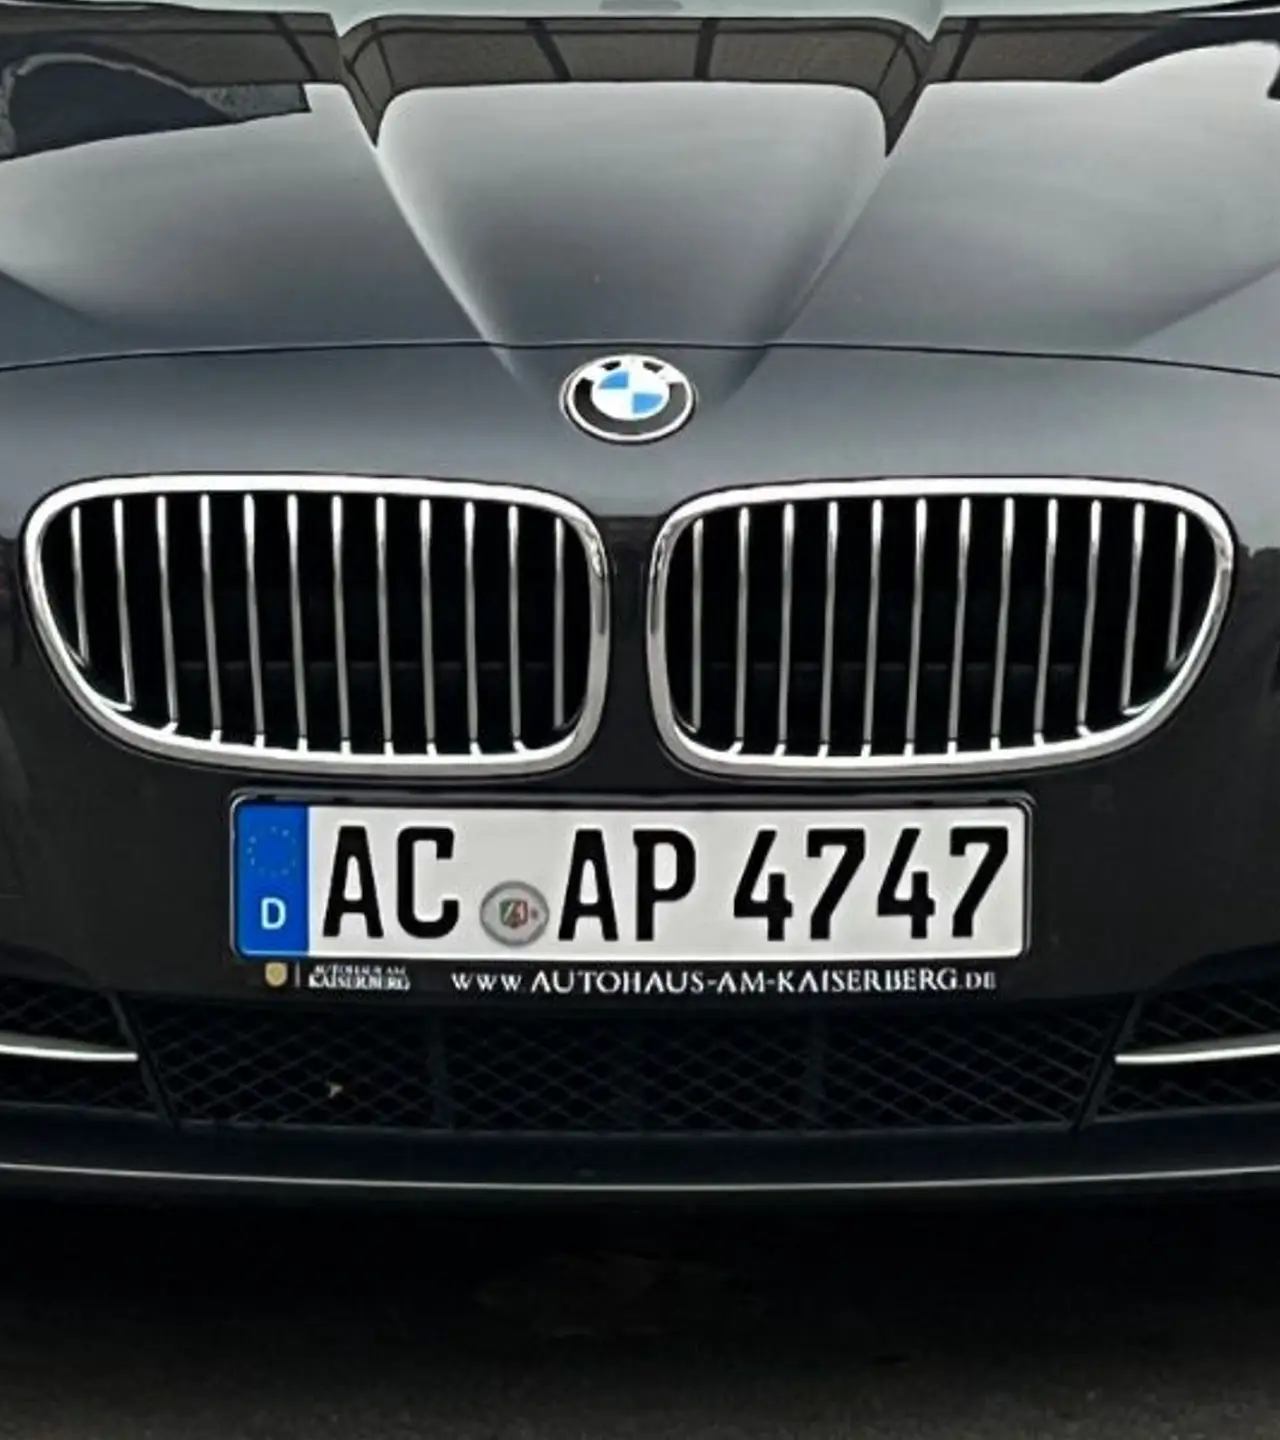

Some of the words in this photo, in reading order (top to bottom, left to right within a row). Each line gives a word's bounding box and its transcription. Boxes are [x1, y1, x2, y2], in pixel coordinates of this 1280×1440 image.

[261, 898, 286, 930] D
[322, 825, 460, 940] AC
[558, 828, 696, 942] AP
[733, 827, 1011, 942] 4747
